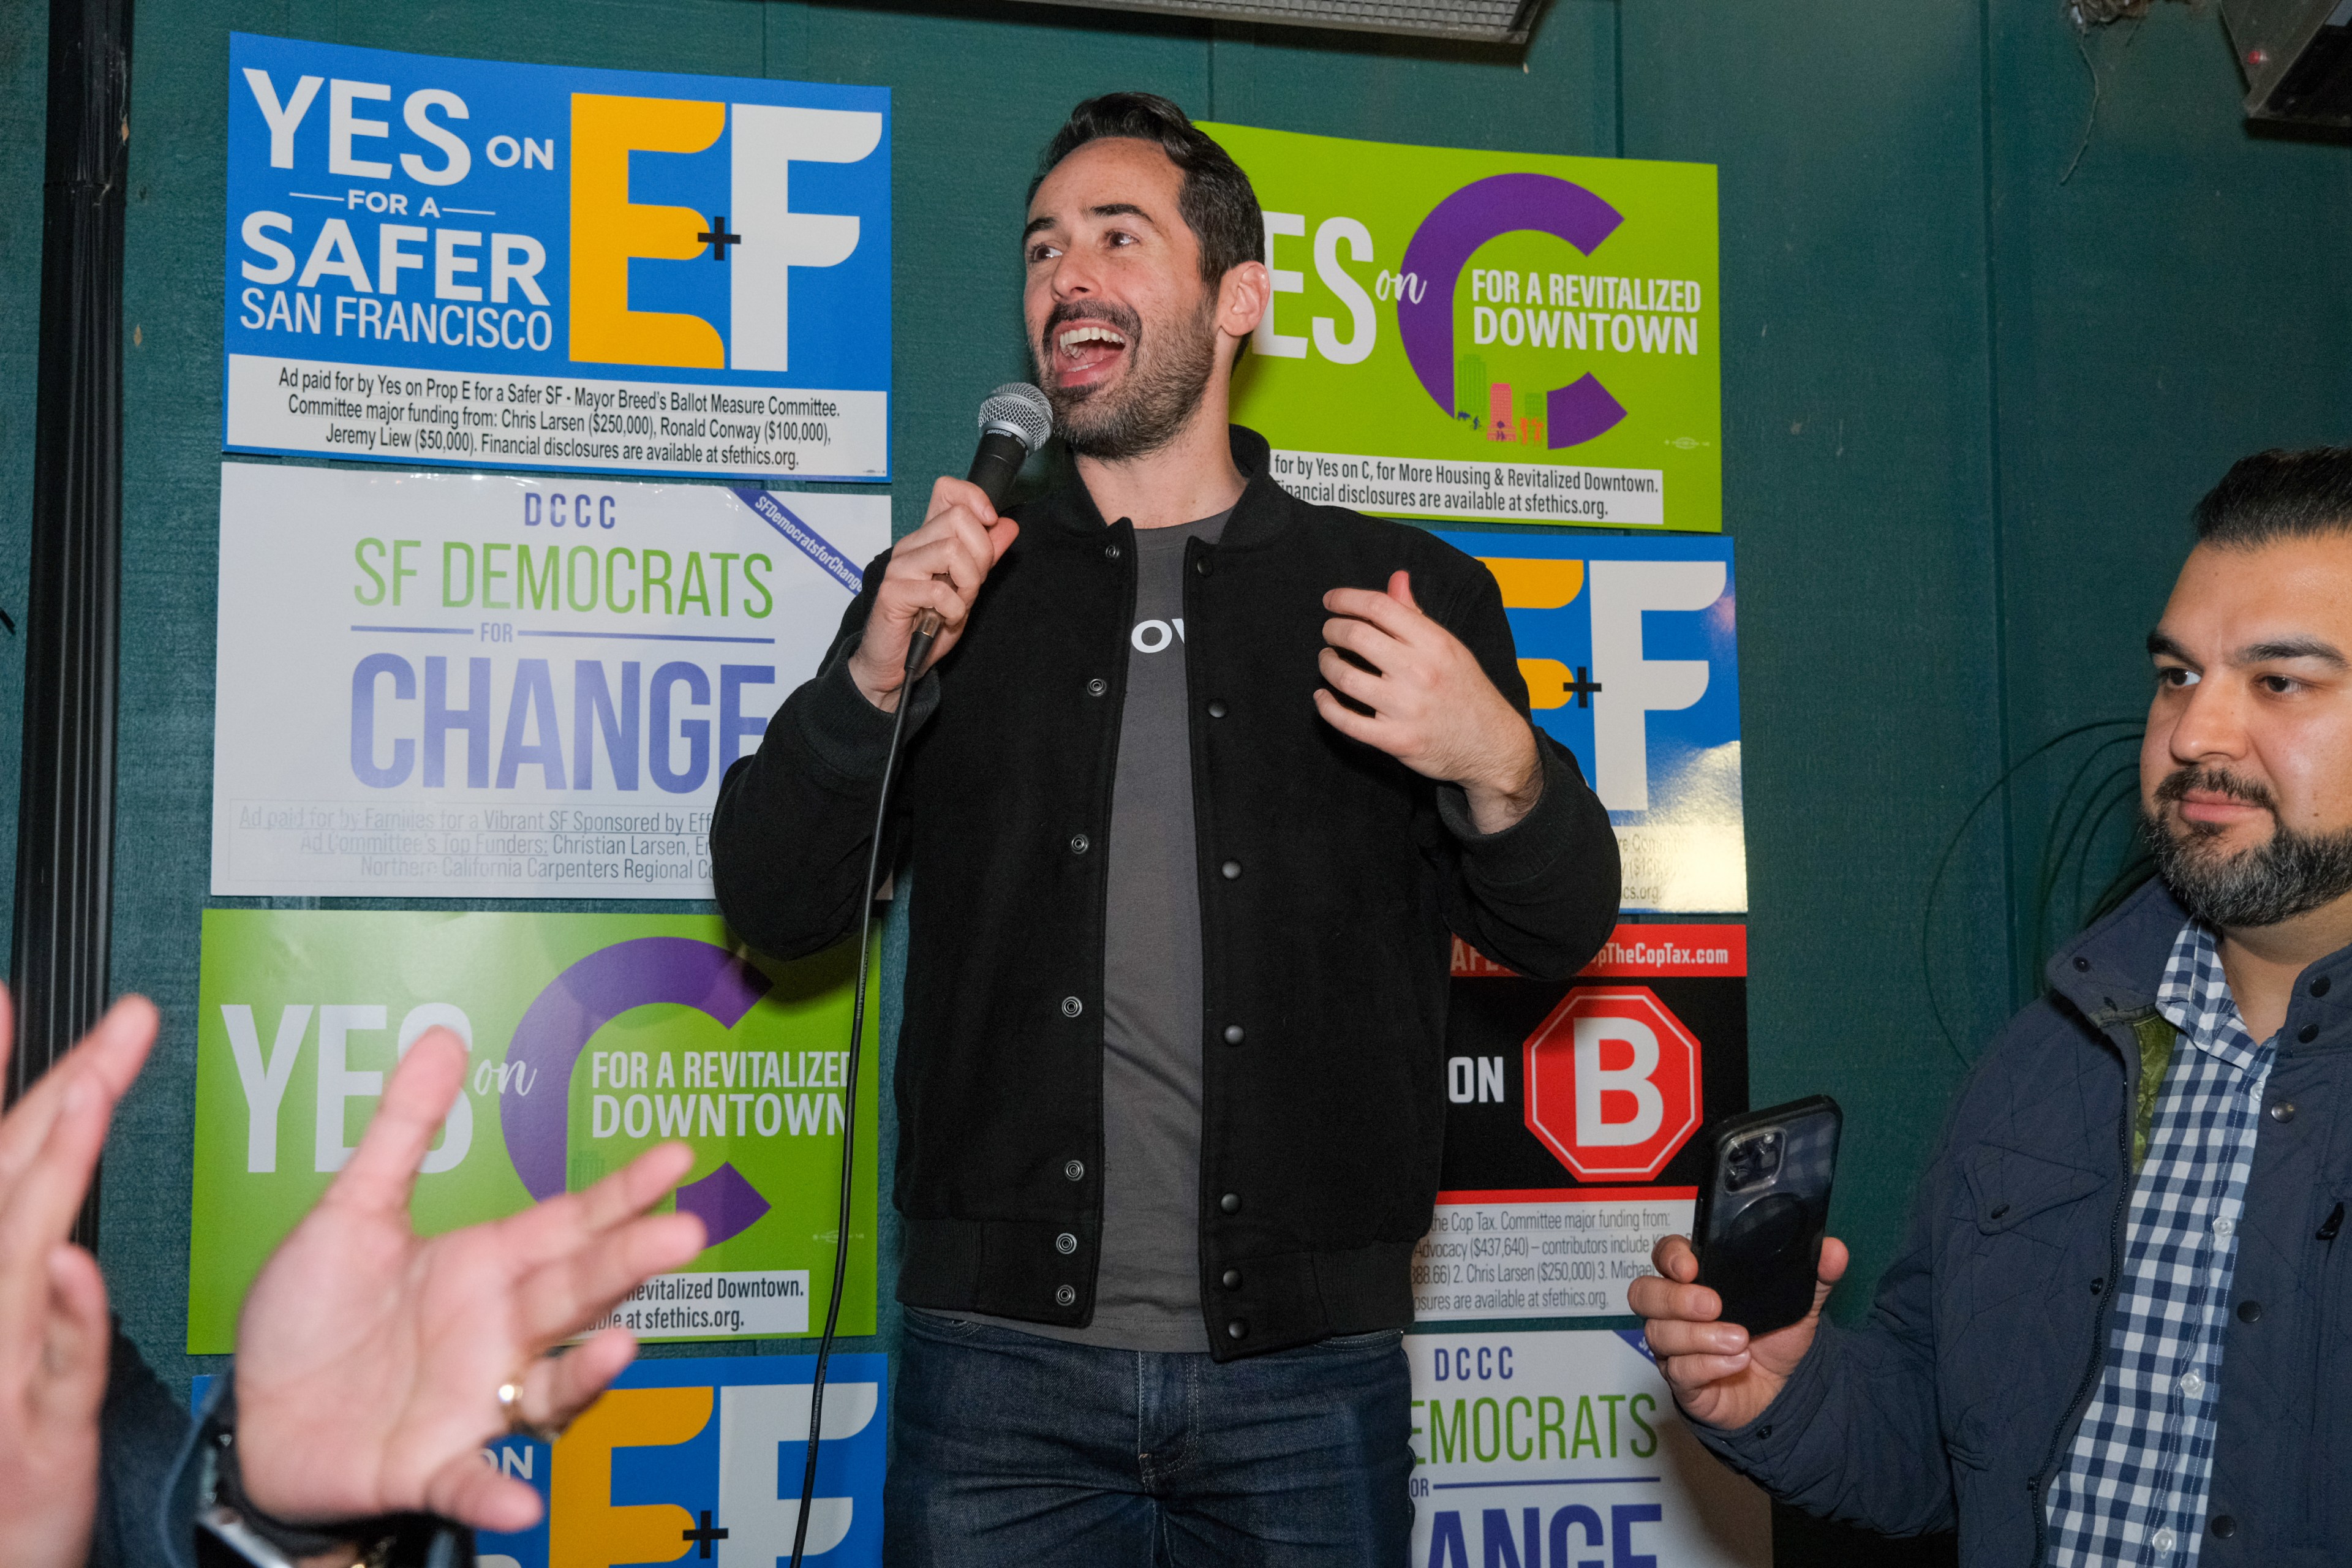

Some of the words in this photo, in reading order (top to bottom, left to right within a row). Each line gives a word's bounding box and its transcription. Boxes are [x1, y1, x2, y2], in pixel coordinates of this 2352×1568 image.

[241, 67, 472, 186] YES
[486, 134, 554, 171] ON
[347, 188, 409, 216] FOR
[418, 195, 441, 219] A
[241, 210, 551, 307] SAFER
[1252, 210, 1377, 365] ES
[1376, 270, 1427, 304] on
[1472, 269, 1520, 304] FOR
[1526, 272, 1544, 305] A
[1548, 273, 1701, 313] REVITALIZED
[240, 286, 322, 336] SAN
[335, 295, 553, 352] FRANCISCO
[1397, 173, 1627, 450] C
[1474, 306, 1698, 356] DOWNTOWN
[279, 367, 298, 388] Ad
[303, 370, 331, 391] paid
[335, 371, 354, 392] for
[358, 373, 374, 398] by
[377, 374, 401, 396] Yes
[405, 381, 422, 398] on
[427, 378, 458, 404] Prop
[462, 380, 470, 400] E
[475, 382, 492, 402] for
[497, 388, 503, 403] a
[508, 383, 541, 404] Safer
[545, 386, 562, 405] SF
[575, 387, 615, 412] Mayor
[671, 391, 707, 413] Ballot
[711, 394, 764, 415] Measure
[769, 396, 840, 418] Committee.
[288, 394, 363, 418] Committee
[366, 400, 404, 426] major
[408, 402, 458, 429] funding
[462, 409, 497, 428] from:
[502, 409, 535, 430] Chris
[540, 410, 584, 432] Larsen
[589, 413, 657, 440] ($250,000),
[661, 417, 706, 438] Ronald
[709, 418, 761, 444] Conway
[764, 420, 831, 446] ($100,000),
[326, 423, 376, 450] Jeremy
[380, 427, 412, 448] Liew
[415, 428, 477, 457] ($50,000).
[481, 434, 540, 456] Financial
[544, 437, 619, 459] disclosures
[623, 445, 643, 461] are
[647, 443, 703, 464] available
[706, 447, 718, 464] at
[722, 447, 799, 470] sfethics.org.
[1275, 454, 1294, 473] for
[1297, 456, 1313, 480] by
[1316, 458, 1338, 478] Yes
[1342, 463, 1358, 479] on
[1362, 461, 1373, 481] C,
[1376, 462, 1395, 481] for
[1399, 463, 1432, 483] More
[1437, 466, 1490, 489] Housing
[1494, 468, 1504, 486] &
[1508, 469, 1580, 490] Revitalized
[1585, 472, 1658, 494] Downtown.
[524, 492, 616, 529] DCCC
[1276, 480, 1335, 502] inancial
[1338, 484, 1415, 507] disclosures
[1419, 492, 1441, 508] are
[1444, 491, 1505, 511] available
[1509, 496, 1522, 512] at
[1525, 495, 1608, 519] sfethics.org.
[353, 537, 421, 608] SF
[443, 541, 774, 619] DEMOCRATS
[481, 622, 513, 644] FOR
[239, 806, 262, 827] Ad
[268, 807, 304, 832] paid
[309, 808, 334, 828] for
[340, 808, 361, 832] by
[440, 810, 464, 830] for
[470, 815, 479, 829] a
[484, 810, 545, 831] Vibrant
[549, 810, 568, 831] SF
[574, 812, 660, 834] Sponsored
[666, 813, 684, 836] by
[301, 832, 323, 853] Ad
[442, 833, 470, 856] Top
[476, 834, 548, 854] Funders:
[553, 834, 625, 854] Christian
[631, 835, 690, 858] Larsen,
[443, 857, 522, 878] California
[527, 858, 618, 881] Carpenters
[624, 859, 692, 882] Regional
[474, 1059, 537, 1096] on
[593, 1051, 647, 1089] FOR
[655, 1051, 677, 1088] A
[1448, 1055, 1504, 1103] ON
[1574, 1017, 1664, 1147] B
[499, 937, 772, 1253] C
[593, 1093, 846, 1138] DOWNTOWN
[1452, 1212, 1473, 1235] Cop
[1476, 1212, 1498, 1232] Tax.
[1501, 1210, 1562, 1231] Committee
[1565, 1210, 1595, 1233] major
[1599, 1208, 1640, 1232] funding
[1642, 1209, 1670, 1227] from:
[1415, 1238, 1468, 1261] Advocacy
[1471, 1237, 1528, 1260] ($437,640)
[1542, 1233, 1608, 1256] contributors
[1611, 1231, 1649, 1253] include
[717, 1276, 804, 1299] Downtown.
[1453, 1264, 1463, 1284] 2.
[1467, 1263, 1495, 1284] Chris
[1499, 1262, 1535, 1283] Larsen
[1538, 1261, 1595, 1284] ($250,000)
[1598, 1262, 1608, 1280] 3.
[1611, 1259, 1655, 1280] Michael
[1415, 1295, 1450, 1311] osures
[1453, 1294, 1472, 1310] are
[1475, 1289, 1525, 1310] available
[1528, 1290, 1539, 1308] at
[1542, 1286, 1608, 1311] sfethics.org.
[626, 1310, 641, 1329] at
[645, 1306, 744, 1332] sfethics.org.
[1434, 1346, 1513, 1382] DCCC
[1410, 1478, 1429, 1497] OR
[1428, 1504, 1662, 1568] ANGE
